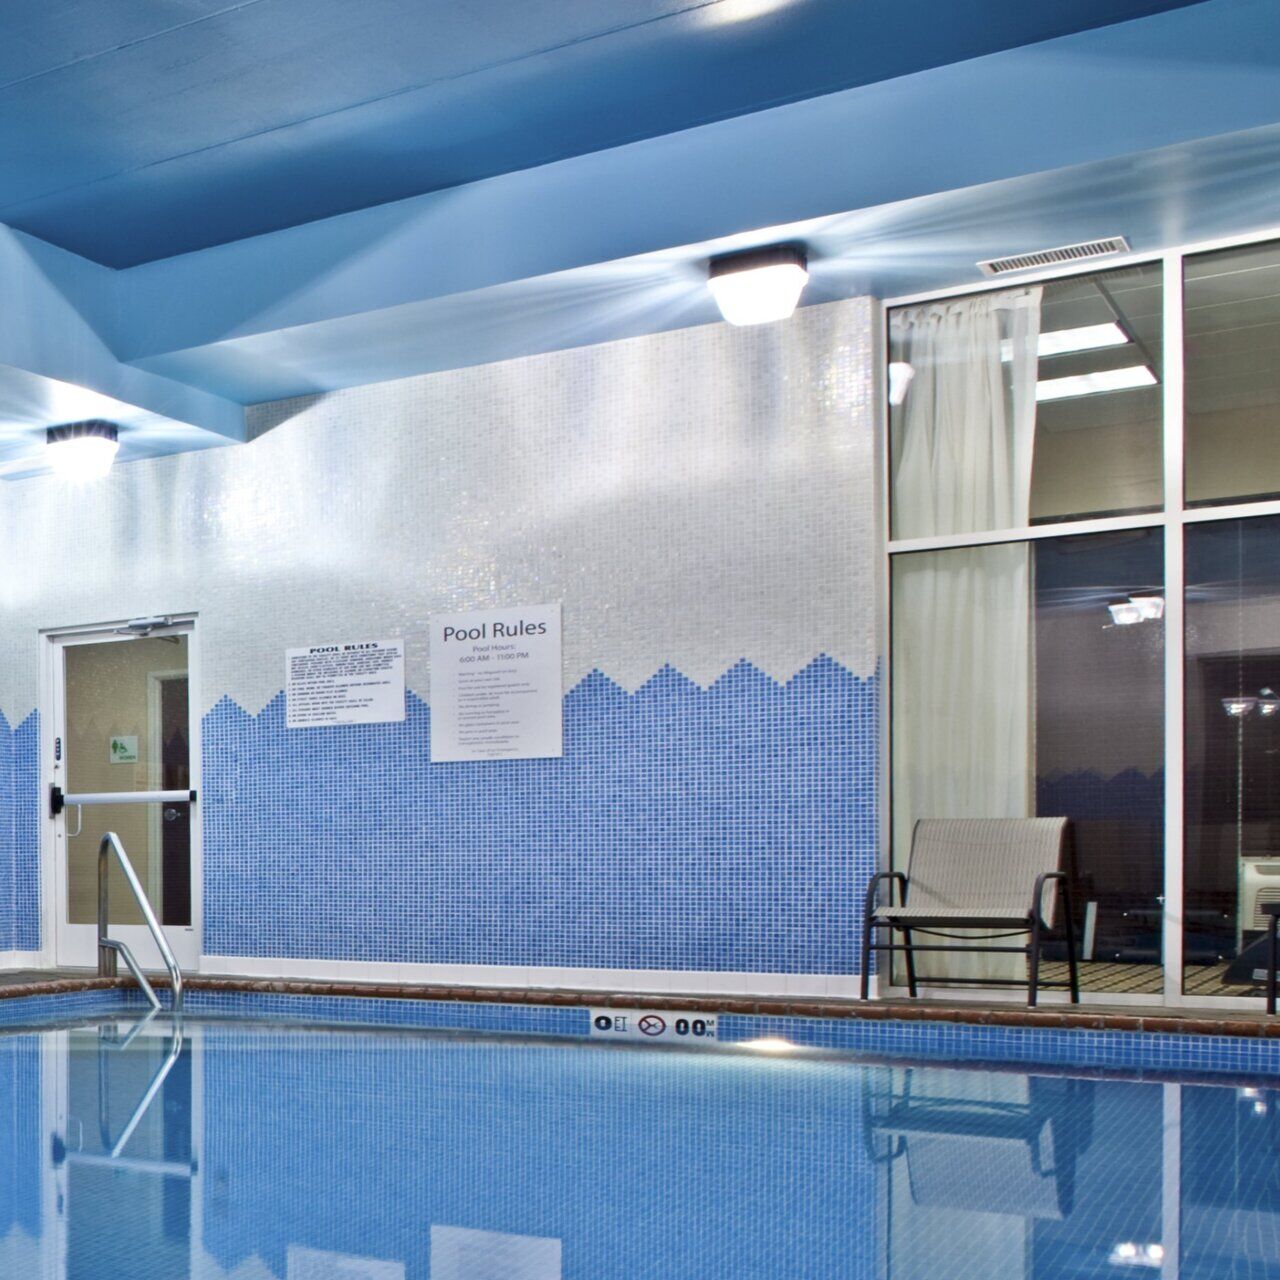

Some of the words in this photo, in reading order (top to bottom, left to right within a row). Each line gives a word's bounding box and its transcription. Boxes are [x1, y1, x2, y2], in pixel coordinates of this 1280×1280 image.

[443, 623, 486, 642] Pool
[493, 620, 546, 638] Rules
[309, 646, 339, 654] POOL
[344, 643, 378, 651] RULES
[472, 644, 490, 653] Pool
[491, 643, 516, 652] Hours:
[459, 655, 475, 664] 6:00
[477, 654, 490, 662] AM
[516, 651, 529, 659] PM
